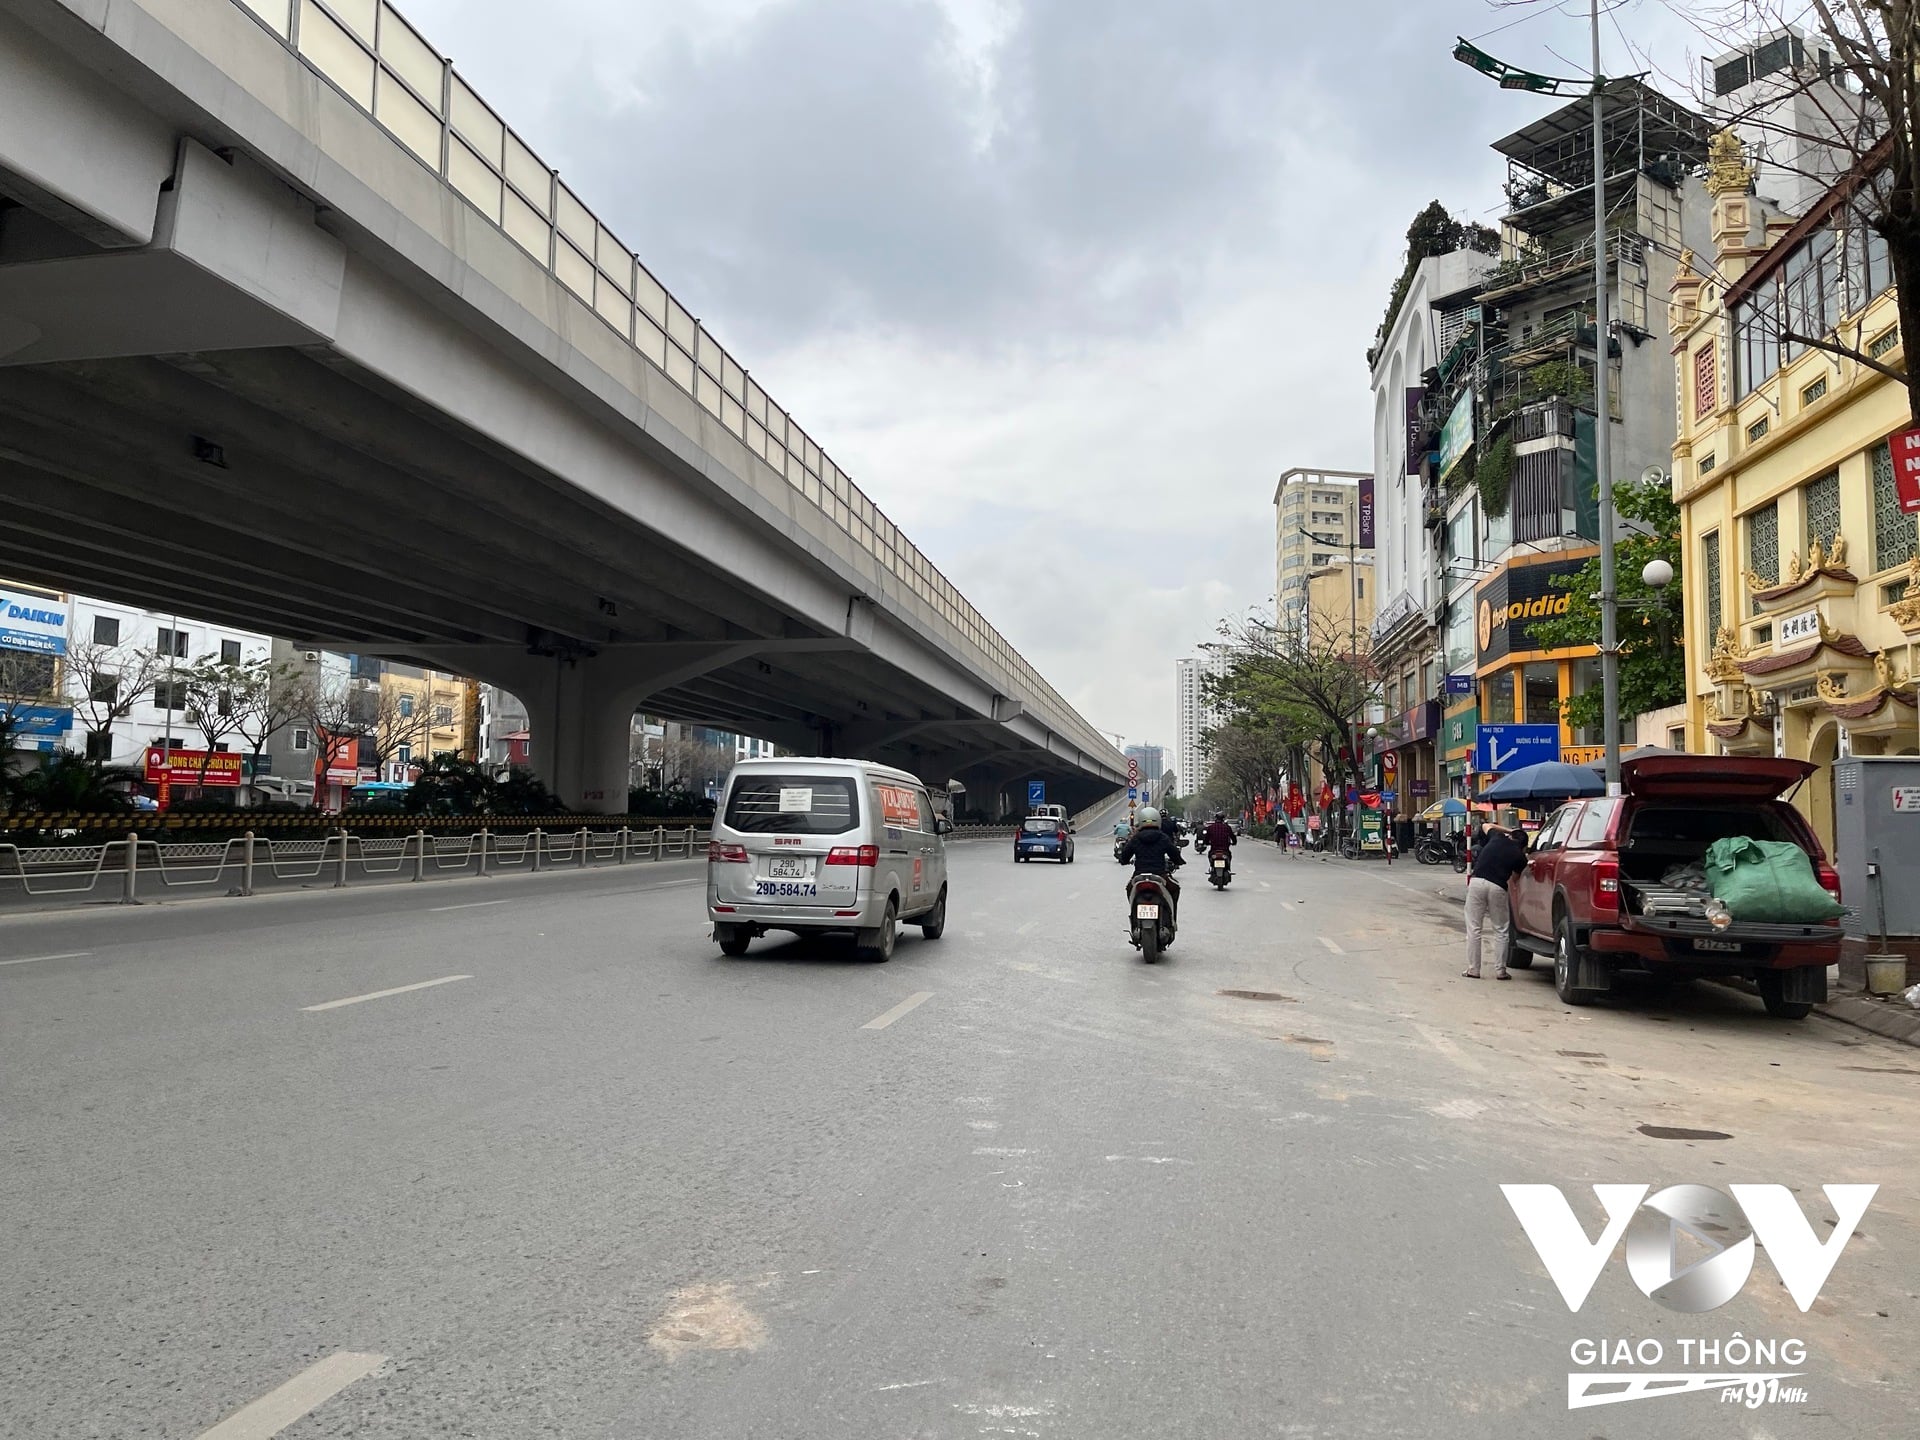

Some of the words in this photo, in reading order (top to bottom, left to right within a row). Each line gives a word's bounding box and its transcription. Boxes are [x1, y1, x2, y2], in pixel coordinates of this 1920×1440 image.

[1362, 504, 1371, 535] TPBank
[8, 605, 65, 626] DAIKIN
[779, 859, 795, 867] 29D
[756, 883, 817, 897] 29D-584.74
